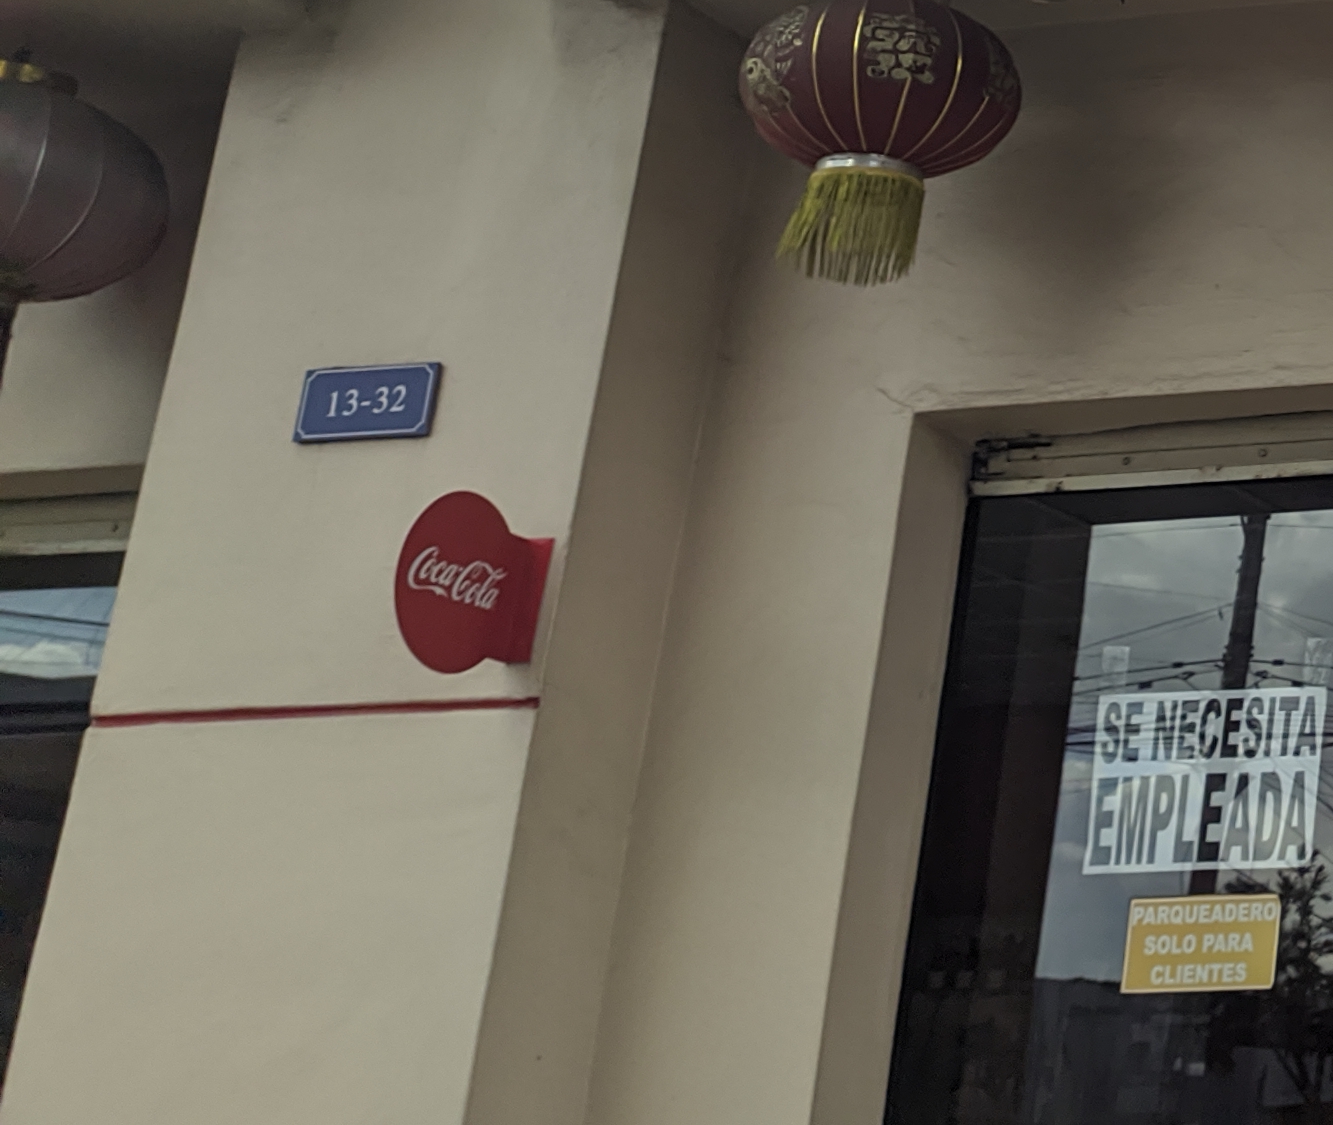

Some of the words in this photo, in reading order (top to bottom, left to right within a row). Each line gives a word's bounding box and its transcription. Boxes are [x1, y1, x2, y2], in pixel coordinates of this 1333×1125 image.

[326, 384, 407, 417] 13-32
[1100, 701, 1145, 764] SE
[1153, 696, 1317, 762] NECESITA
[1089, 770, 1307, 866] EMPLEADA
[1132, 901, 1278, 926] PARQUEADERO
[1143, 933, 1196, 956] SOLO
[1202, 932, 1254, 954] PARA
[1150, 962, 1248, 986] CLIENTES
